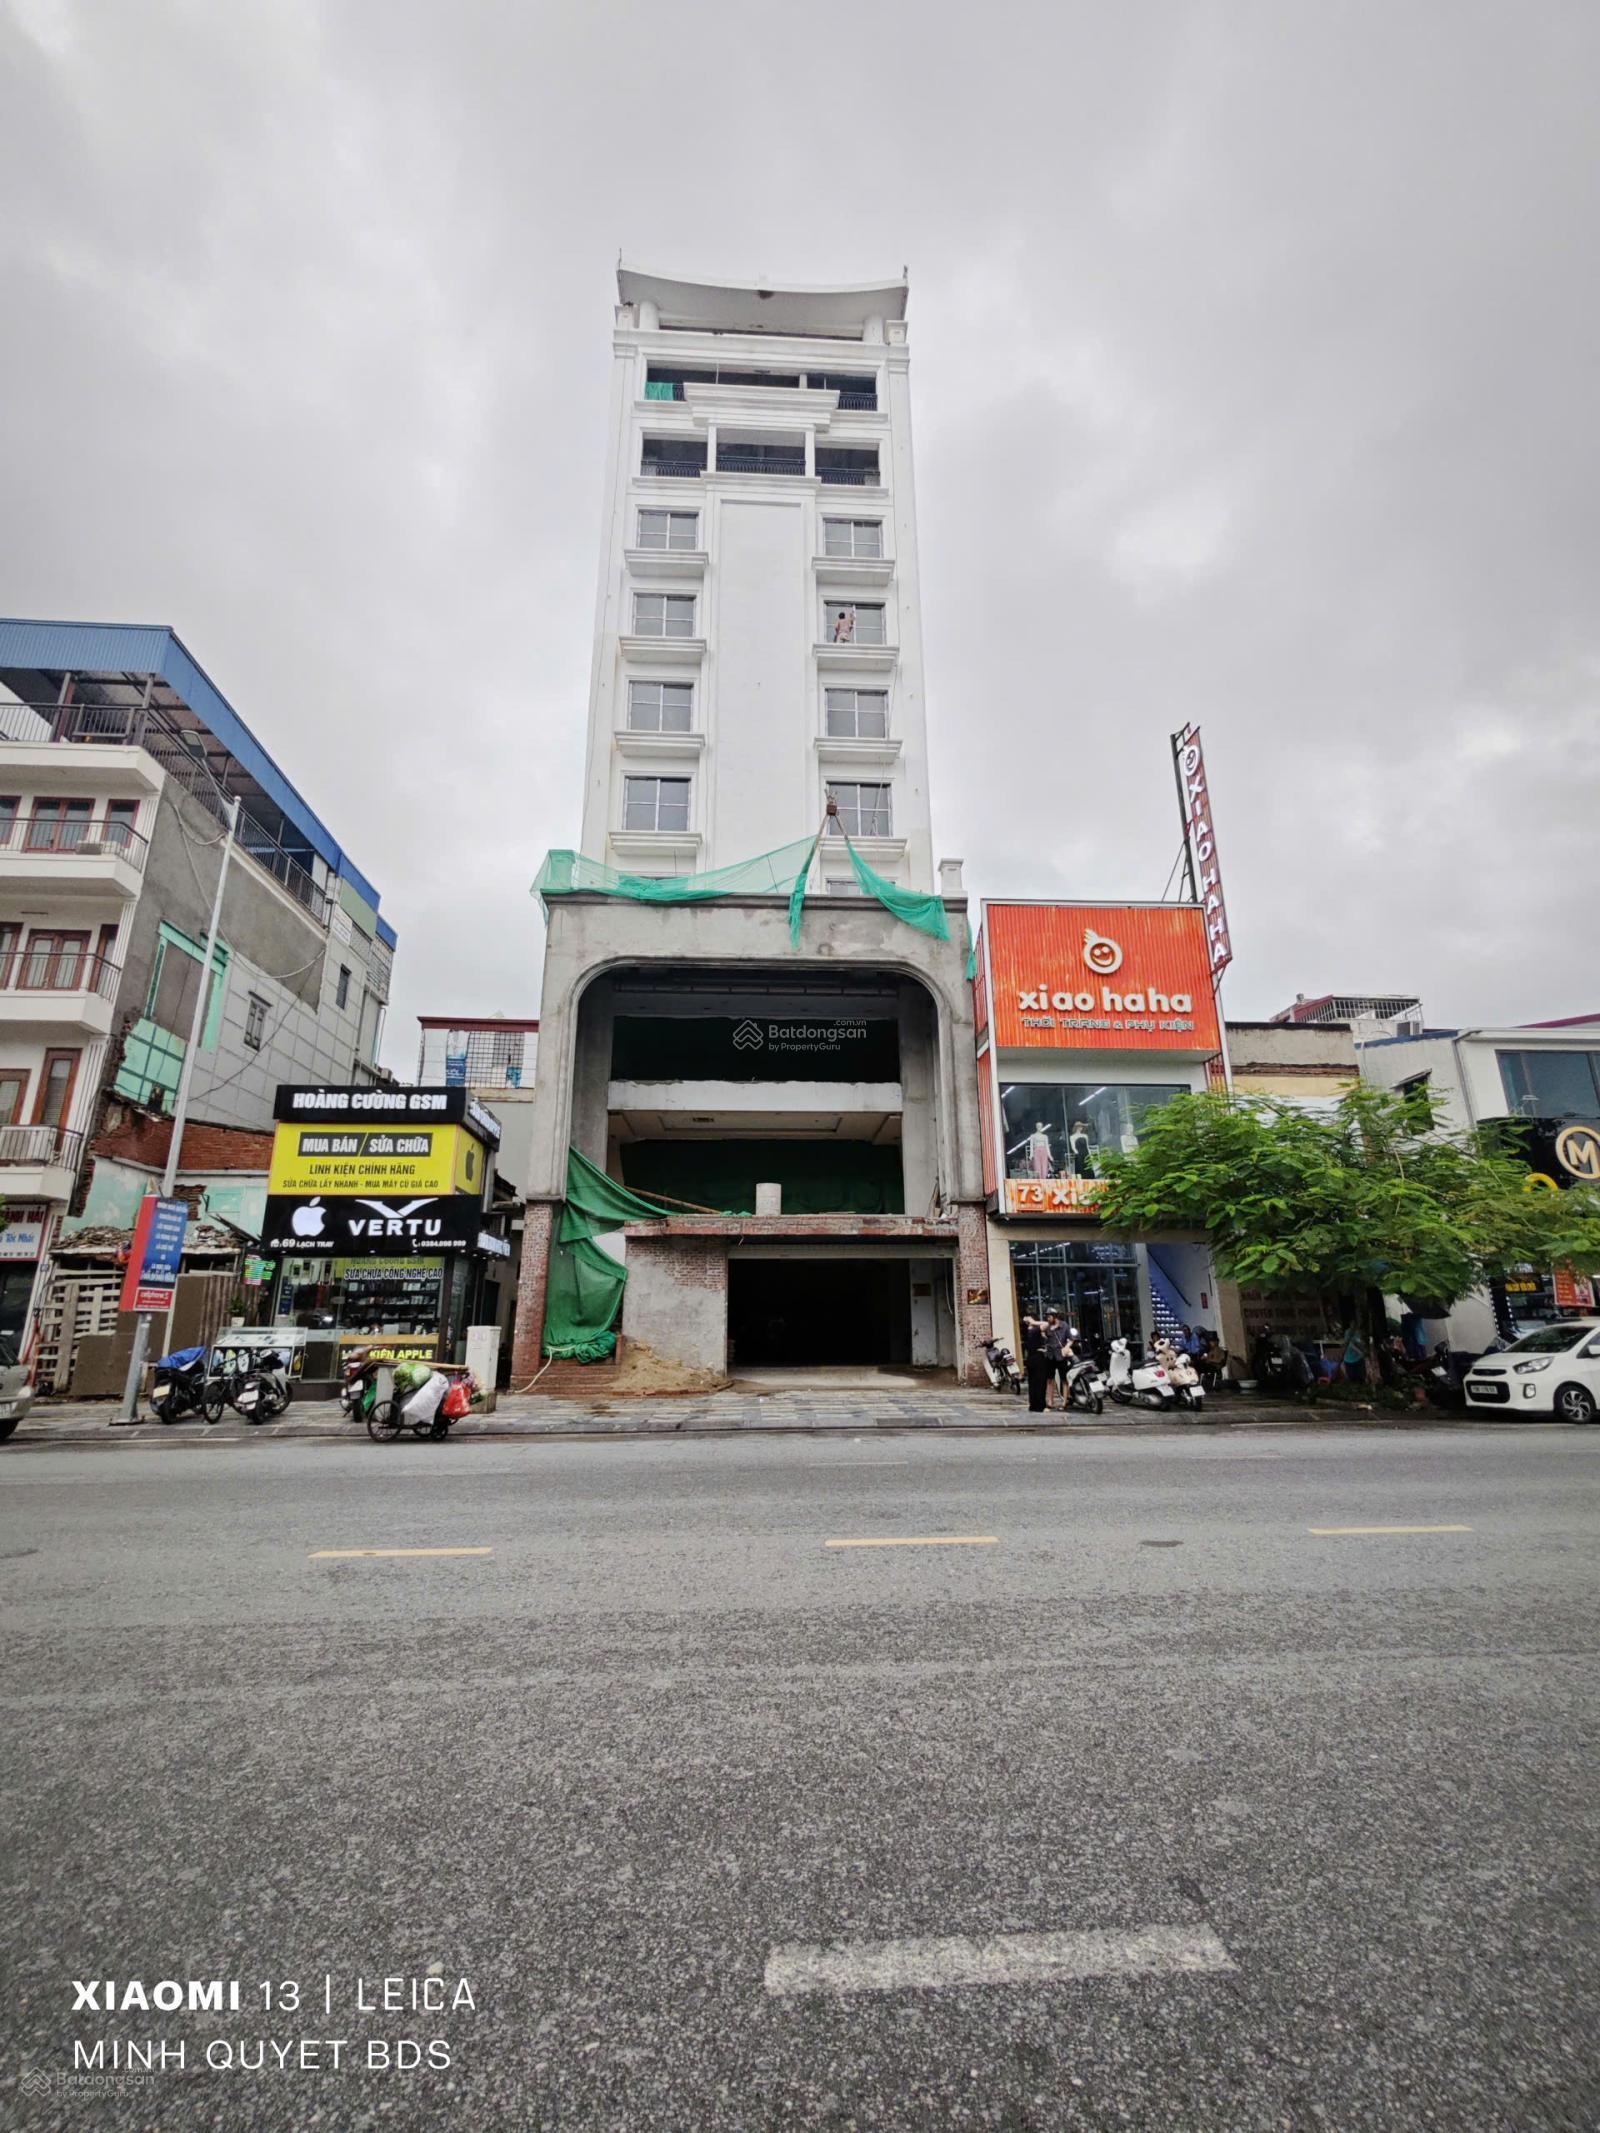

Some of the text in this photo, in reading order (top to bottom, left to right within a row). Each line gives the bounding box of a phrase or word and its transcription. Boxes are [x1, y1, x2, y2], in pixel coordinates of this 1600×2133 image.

[1188, 775, 1227, 963] XIAO HAHA
[1018, 983, 1193, 1012] xiao haha
[1062, 1018, 1110, 1030] TRANG
[292, 1089, 448, 1110] HOÀNG CƯỜNG GSM
[302, 1136, 358, 1152] MUA BÁN
[369, 1134, 429, 1152] SỬA CHỮA
[309, 1164, 330, 1174] LINH
[333, 1162, 355, 1177] KIỆN
[358, 1162, 387, 1174] CHÍNH
[1018, 1186, 1043, 1202] 73
[348, 1219, 442, 1236] VERTU
[427, 1268, 444, 1279] CAO
[396, 1350, 433, 1359] APPLE
